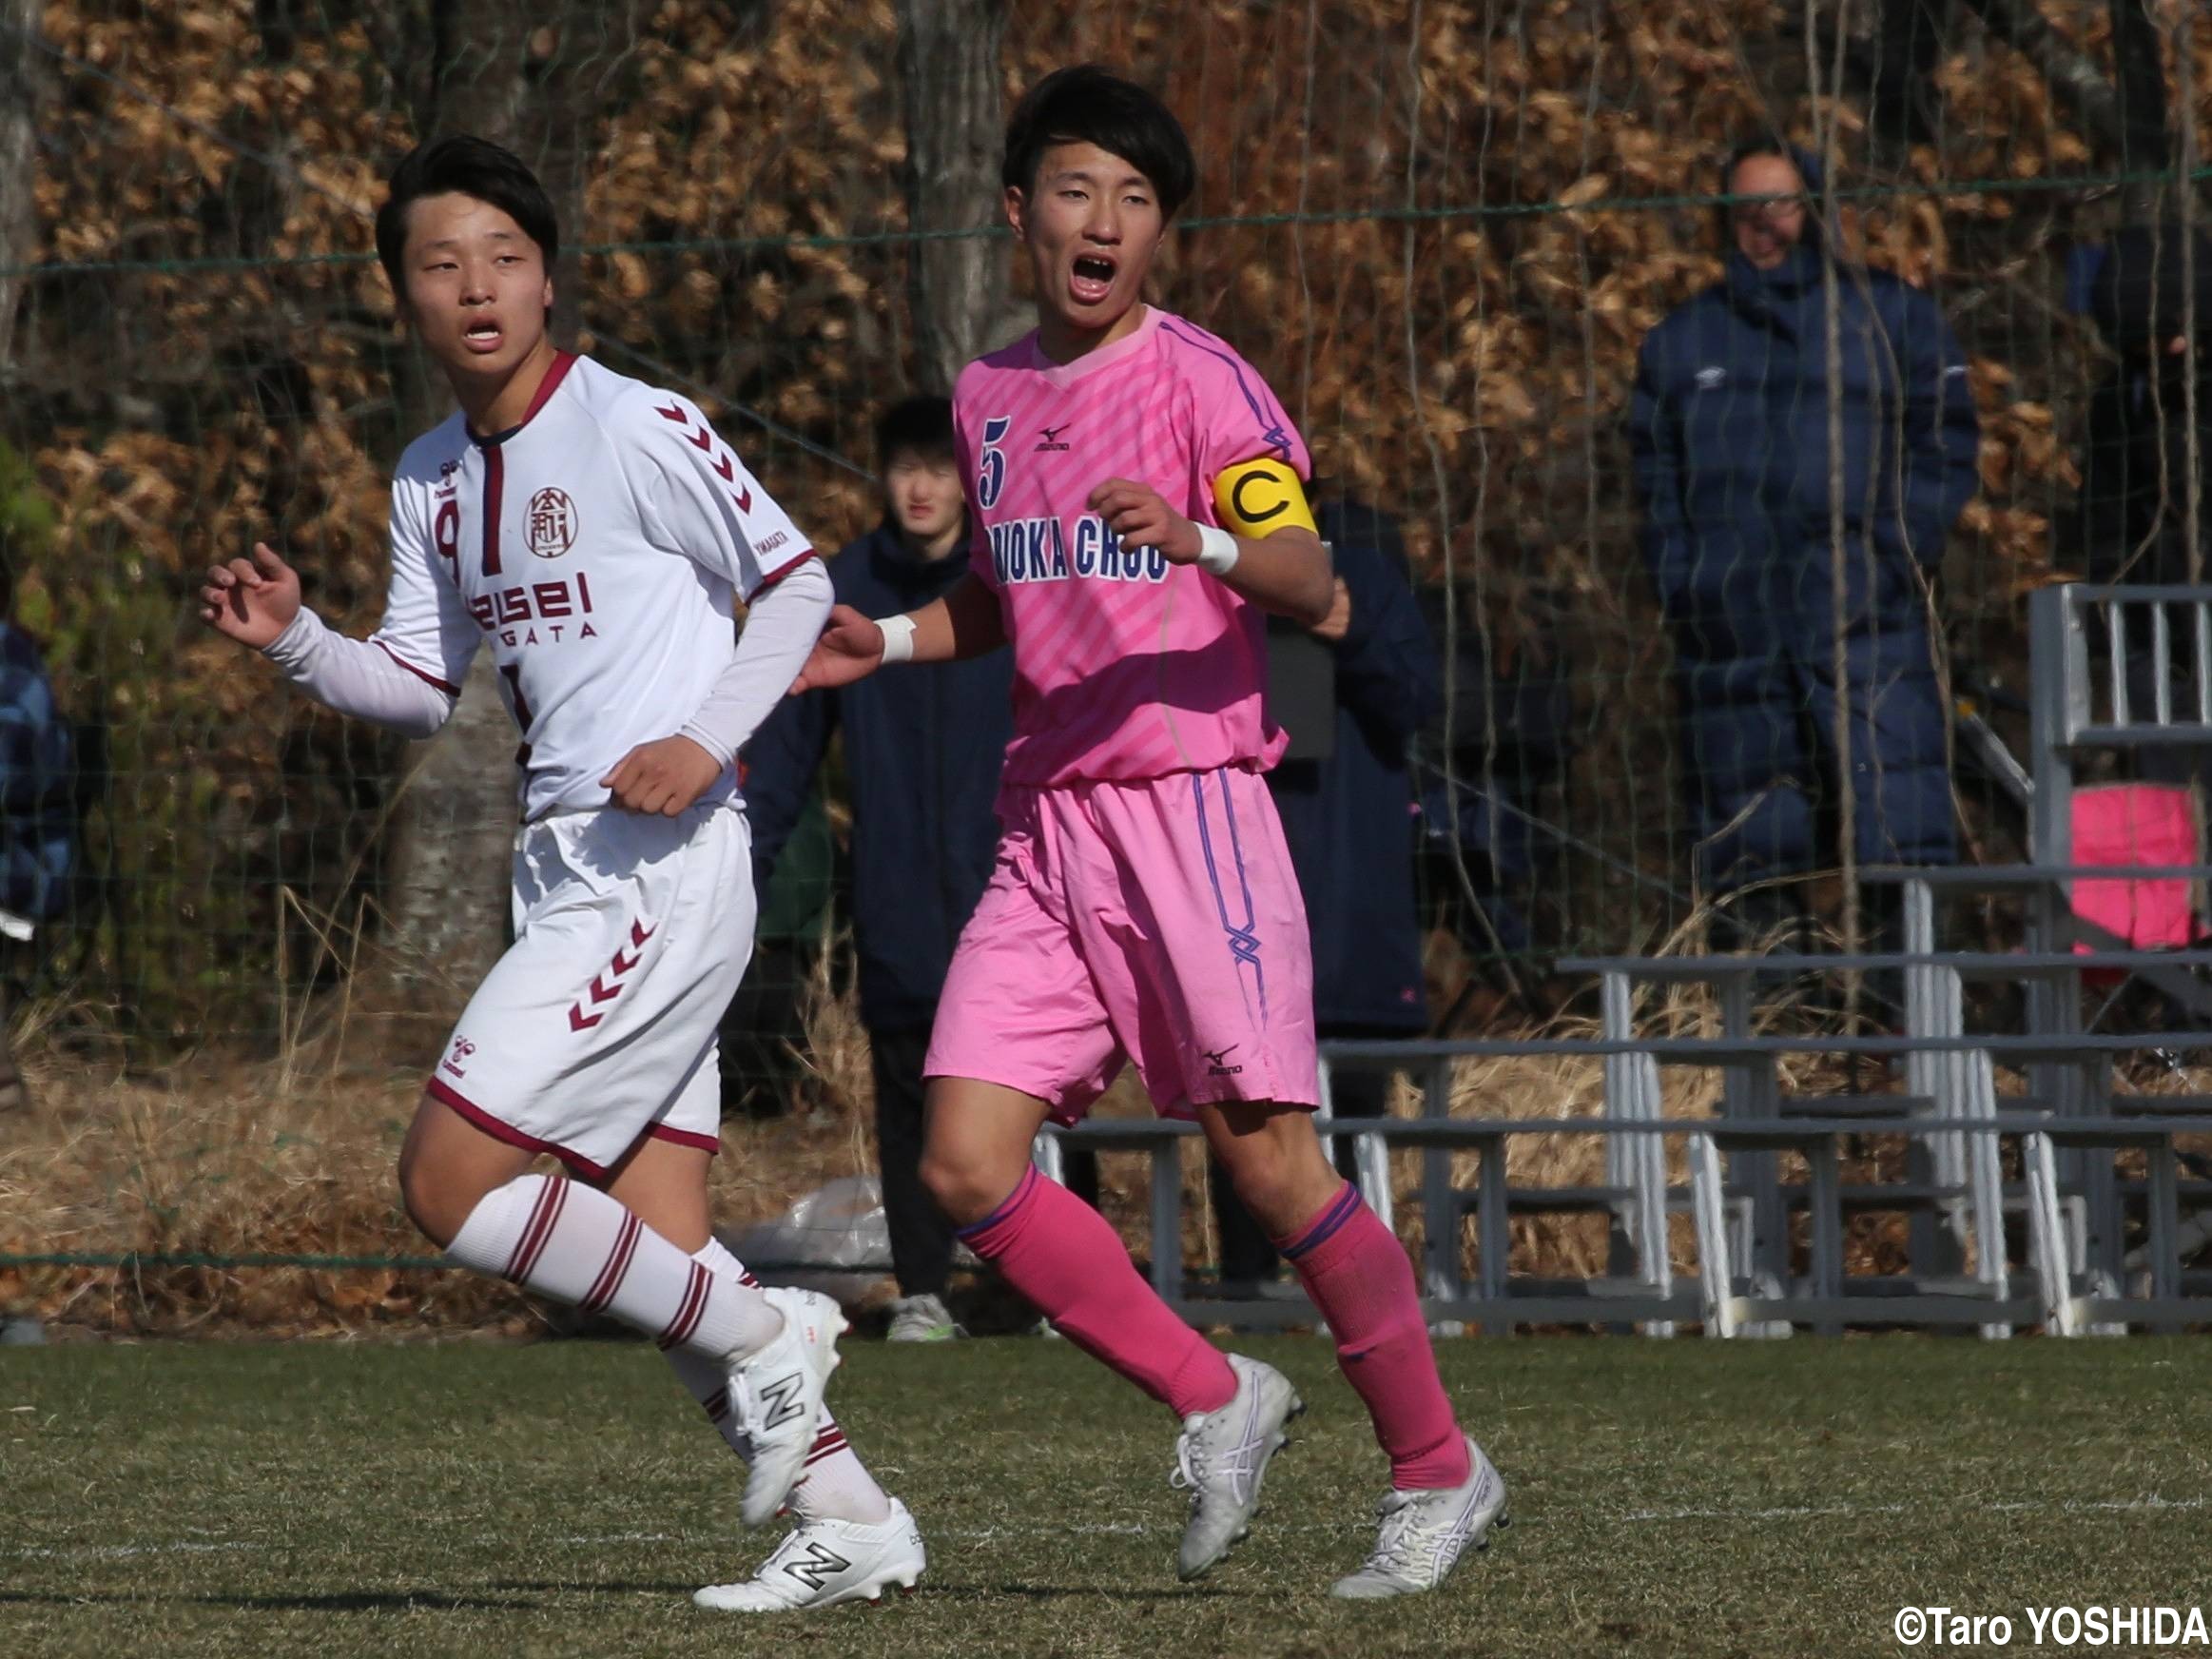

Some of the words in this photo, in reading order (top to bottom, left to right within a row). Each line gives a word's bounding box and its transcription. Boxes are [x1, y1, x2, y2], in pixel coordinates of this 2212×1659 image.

[977, 415, 1011, 511] 5
[1232, 470, 1290, 524] C
[435, 498, 460, 589] 9
[499, 620, 598, 648] GATA
